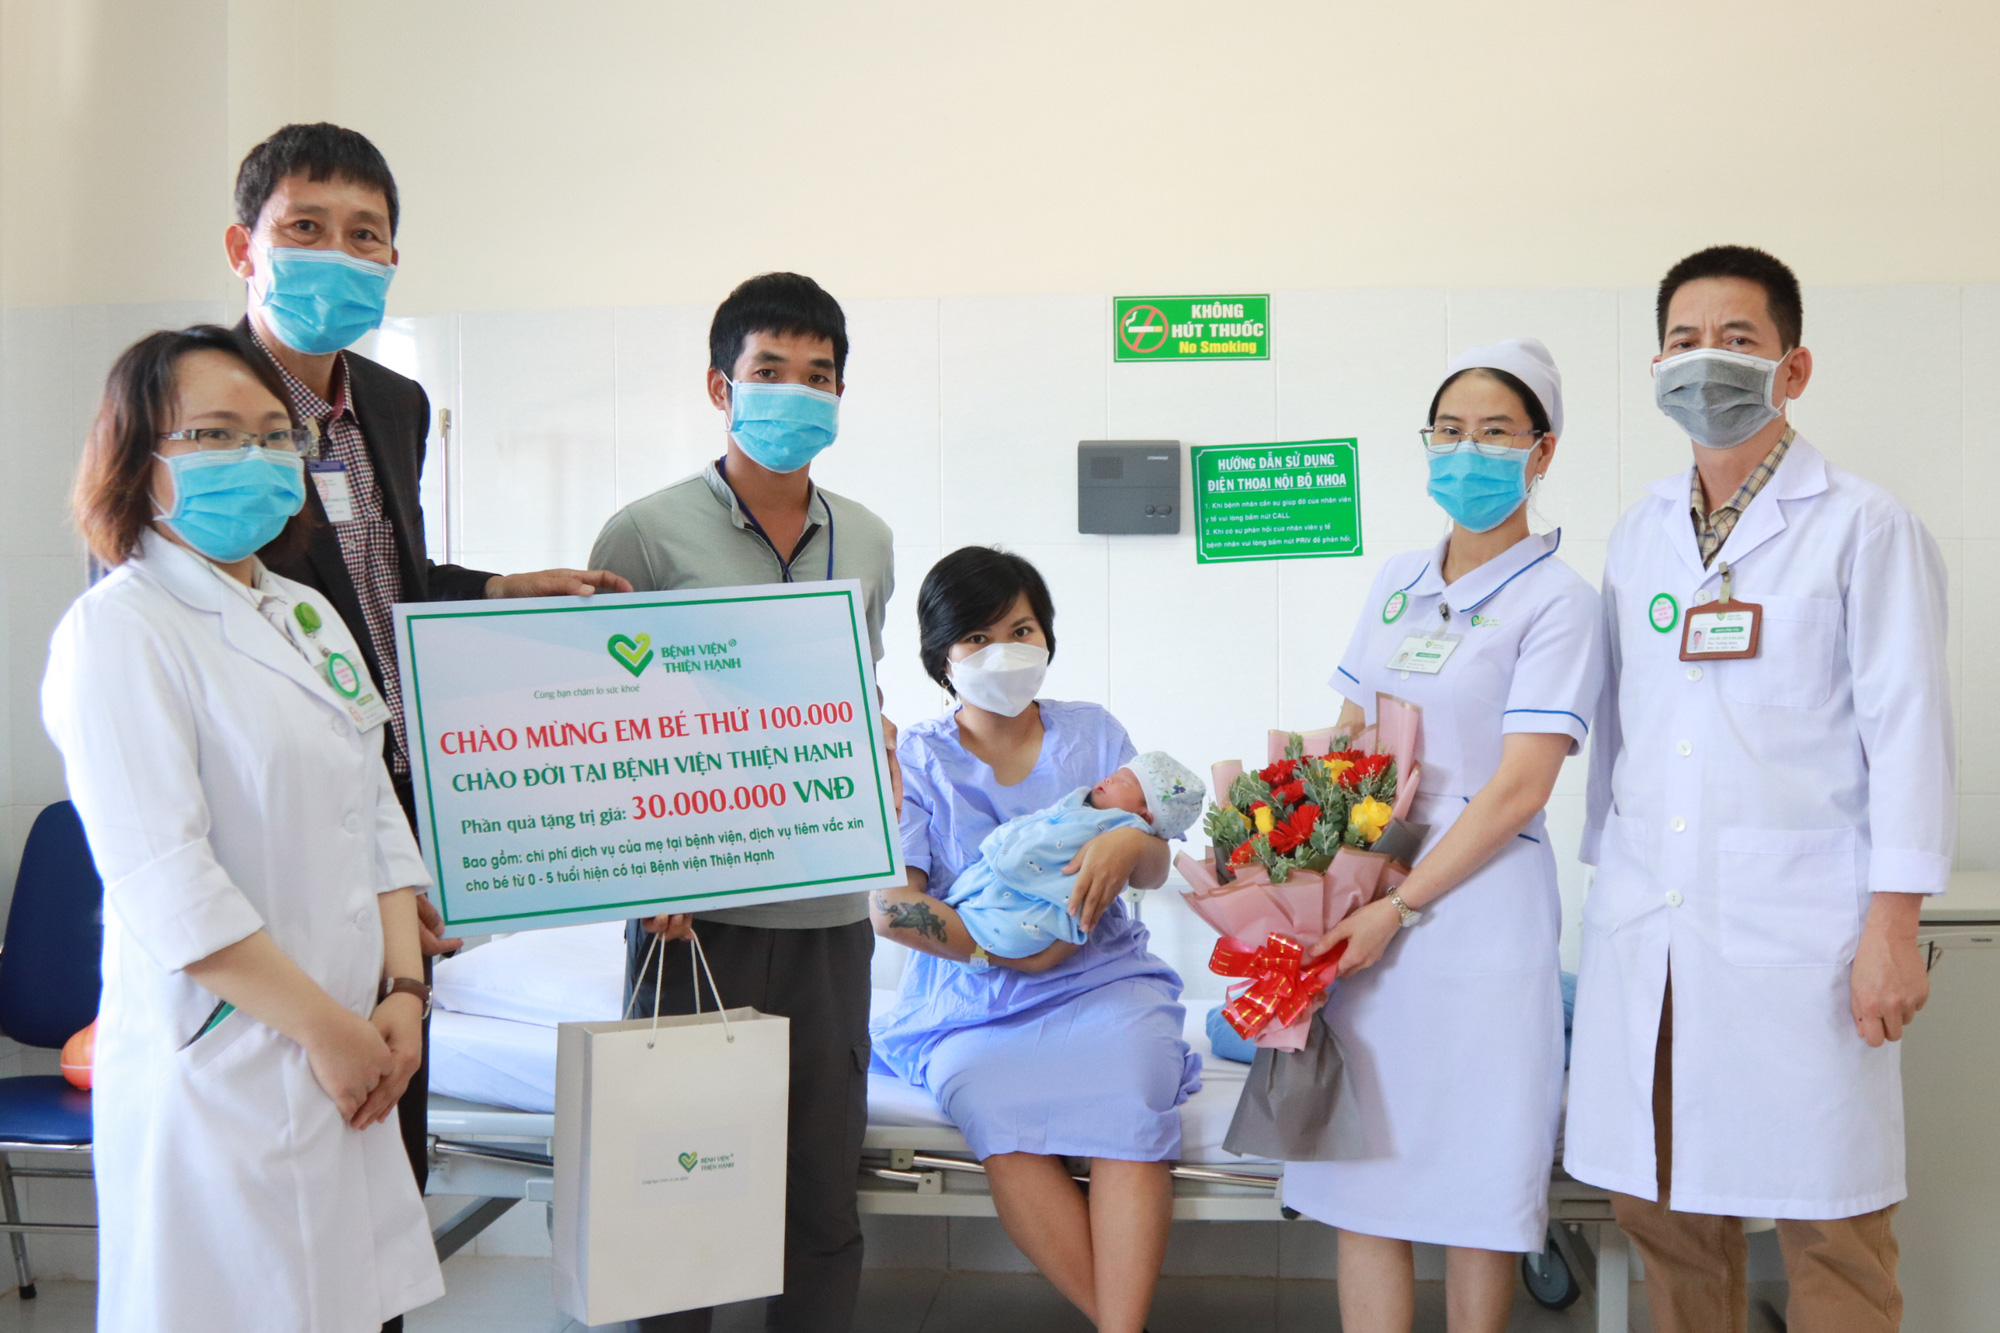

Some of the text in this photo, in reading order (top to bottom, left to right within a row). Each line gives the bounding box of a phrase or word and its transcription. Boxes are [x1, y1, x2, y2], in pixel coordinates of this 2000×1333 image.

[1191, 301, 1244, 319] KHÔNG
[1171, 319, 1264, 338] HÚT THUỐC
[1179, 340, 1257, 354] No Smoking
[1218, 451, 1335, 471] HƯỚNG DẪN SỬ DỤNG
[1208, 472, 1346, 493] ĐIỆN THOẠI NỘI BỘ KHOA
[661, 642, 727, 660] BỆNH VIỆN
[663, 658, 741, 674] THIỆN HẠNH
[557, 689, 571, 698] bạn
[596, 687, 604, 695] lo
[606, 685, 619, 694] sức
[440, 701, 853, 755] CHÀO MỪNG EM BÉ THỨ 100.000
[452, 741, 854, 792] CHÀO ĐỜI TẠI BỆNH VIỆN THIỆN HẠNH
[461, 776, 855, 835] Phần quà tặng trị giá: 30.000.000 VNĐ
[463, 816, 864, 870] Bao gồm: chi phí dịch vụ của mẹ tại bệnh viện, dịch vụ tiêm vắc xin
[465, 878, 490, 892] cho
[493, 875, 509, 890] bé
[512, 873, 526, 887] từ
[528, 873, 536, 886] 0
[546, 871, 554, 884] 5
[557, 865, 580, 883] tuổi
[583, 866, 609, 883] hiện
[612, 863, 629, 877] có
[631, 862, 647, 878] tại
[650, 859, 680, 876] Bệnh
[683, 856, 707, 872] viện
[710, 852, 741, 868] Thiện
[743, 849, 775, 866] Hạnh
